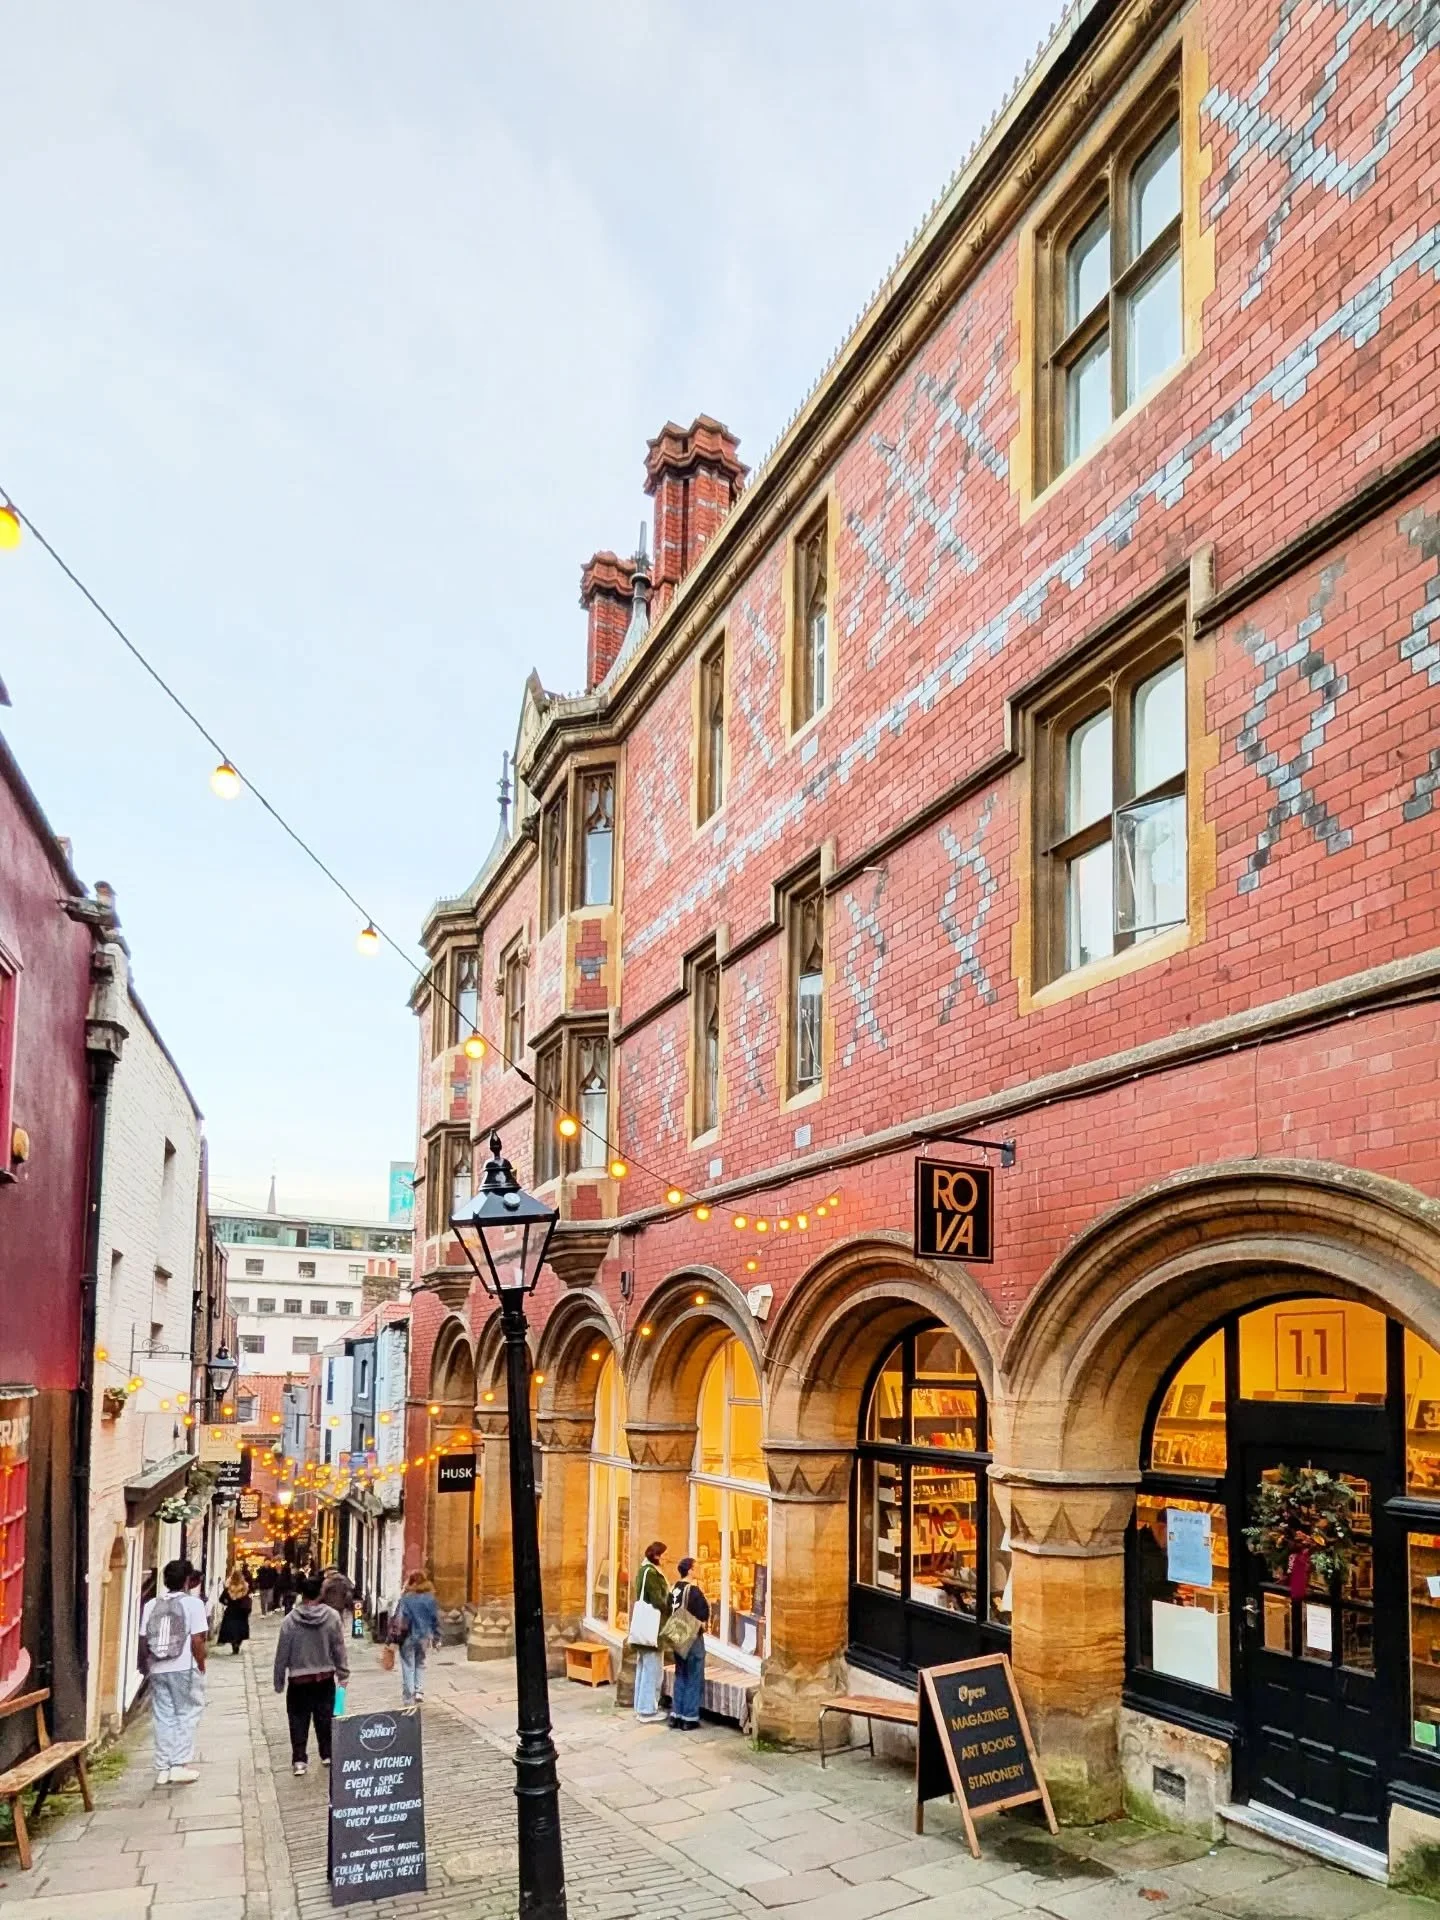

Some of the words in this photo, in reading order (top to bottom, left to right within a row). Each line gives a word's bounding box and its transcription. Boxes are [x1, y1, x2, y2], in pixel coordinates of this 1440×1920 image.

[1289, 1328, 1328, 1376] 11
[441, 1467, 473, 1479] HUSK
[952, 1706, 1009, 1731] MAGAZINES
[962, 1743, 979, 1760] ART
[981, 1735, 1016, 1755] BOOKS
[342, 1759, 361, 1773] BAR
[373, 1755, 413, 1770] KITCHEN
[345, 1776, 374, 1790] EVENT
[379, 1772, 404, 1786] SPACE
[968, 1763, 1024, 1790] STATIONERY
[355, 1788, 371, 1799] FOR
[373, 1785, 393, 1797] HIRE
[332, 1806, 364, 1820] HOSTING
[366, 1804, 378, 1815] POP
[379, 1803, 387, 1813] UP
[389, 1798, 422, 1812] KITCHENS
[345, 1816, 371, 1828] EVERY
[374, 1812, 408, 1825] WEEKEND
[333, 1863, 366, 1877] FOLLOW
[335, 1876, 346, 1887] TO
[347, 1873, 364, 1885] SEE
[396, 1863, 421, 1877] NEXT
